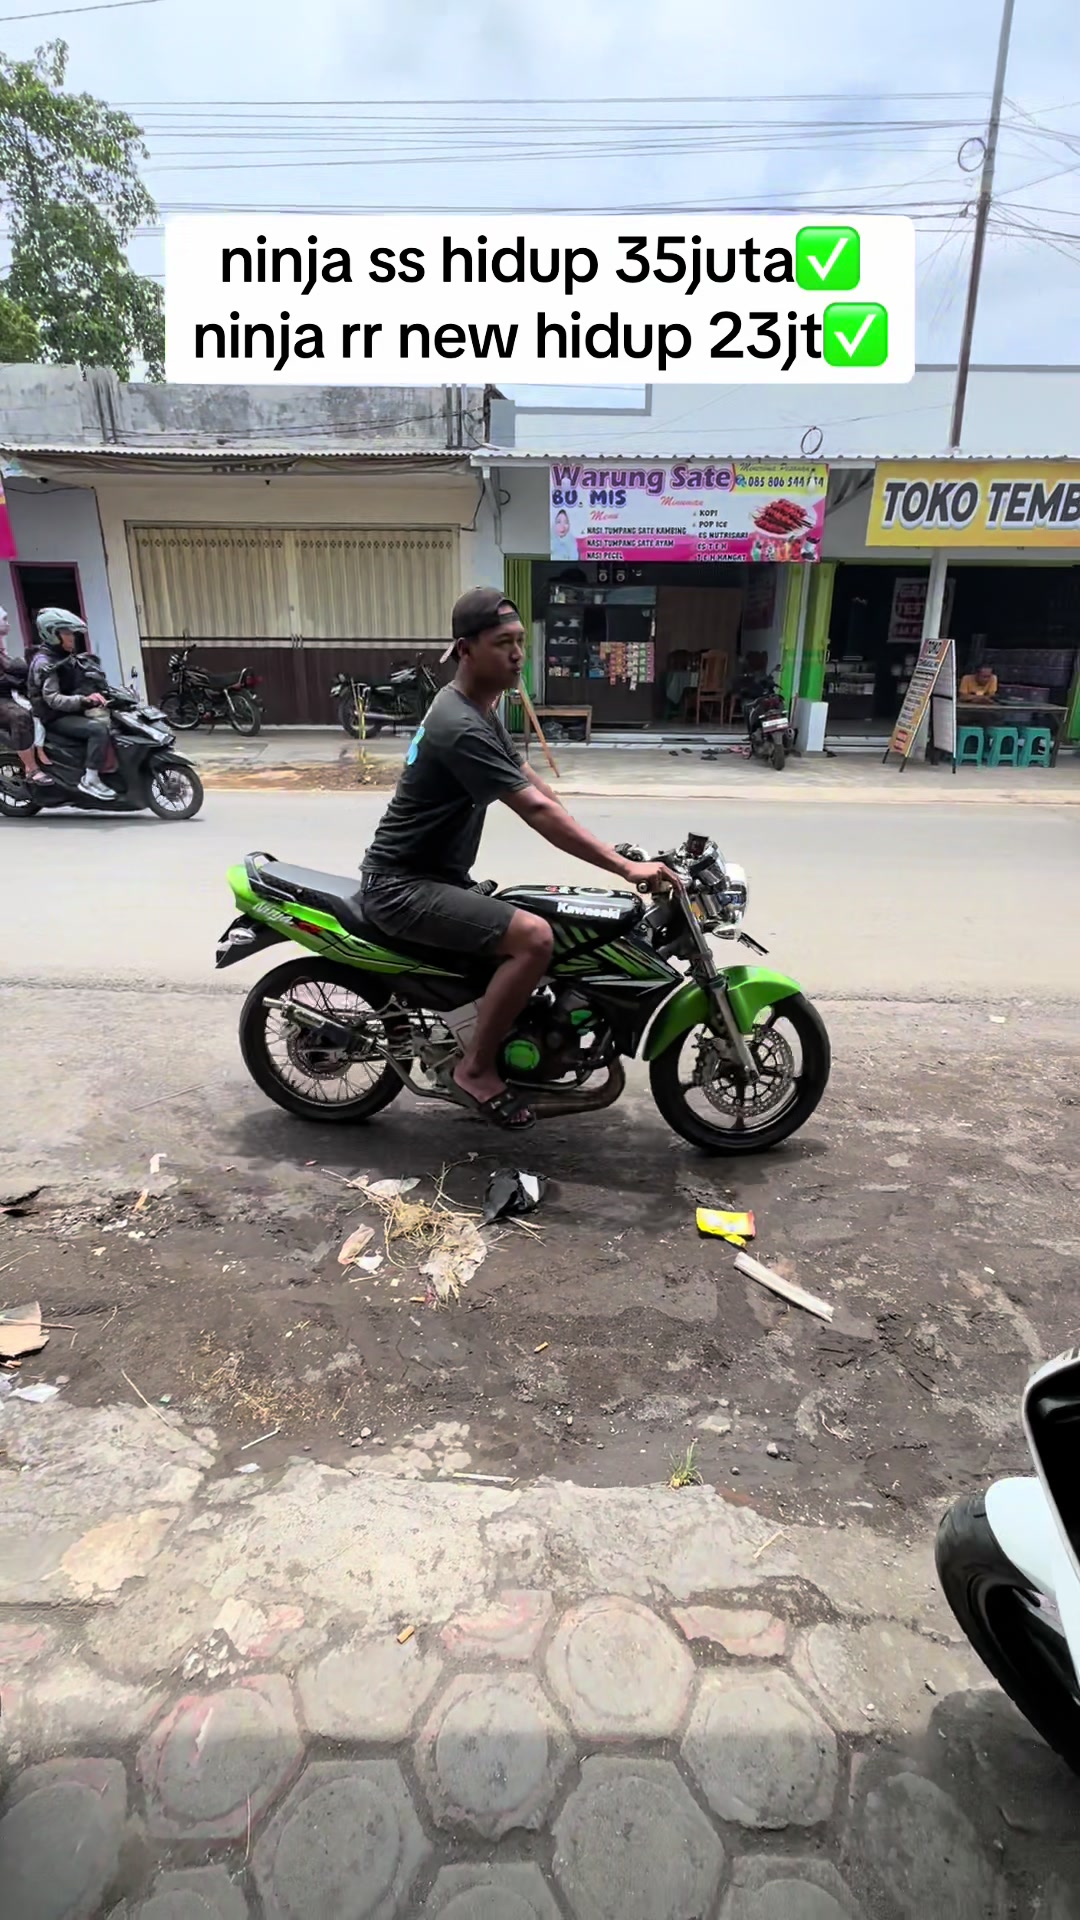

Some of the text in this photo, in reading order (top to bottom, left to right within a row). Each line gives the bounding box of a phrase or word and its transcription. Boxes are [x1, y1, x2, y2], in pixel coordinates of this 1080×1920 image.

[551, 464, 735, 495] Warung Sate
[748, 476, 765, 488] 085
[552, 490, 627, 506] BU. MIS
[883, 481, 1080, 526] TOKO TEMB
[699, 509, 718, 517] KOPI
[604, 527, 637, 535] TUMPANG
[638, 527, 655, 535] SATE
[556, 901, 621, 919] Kawasaki
